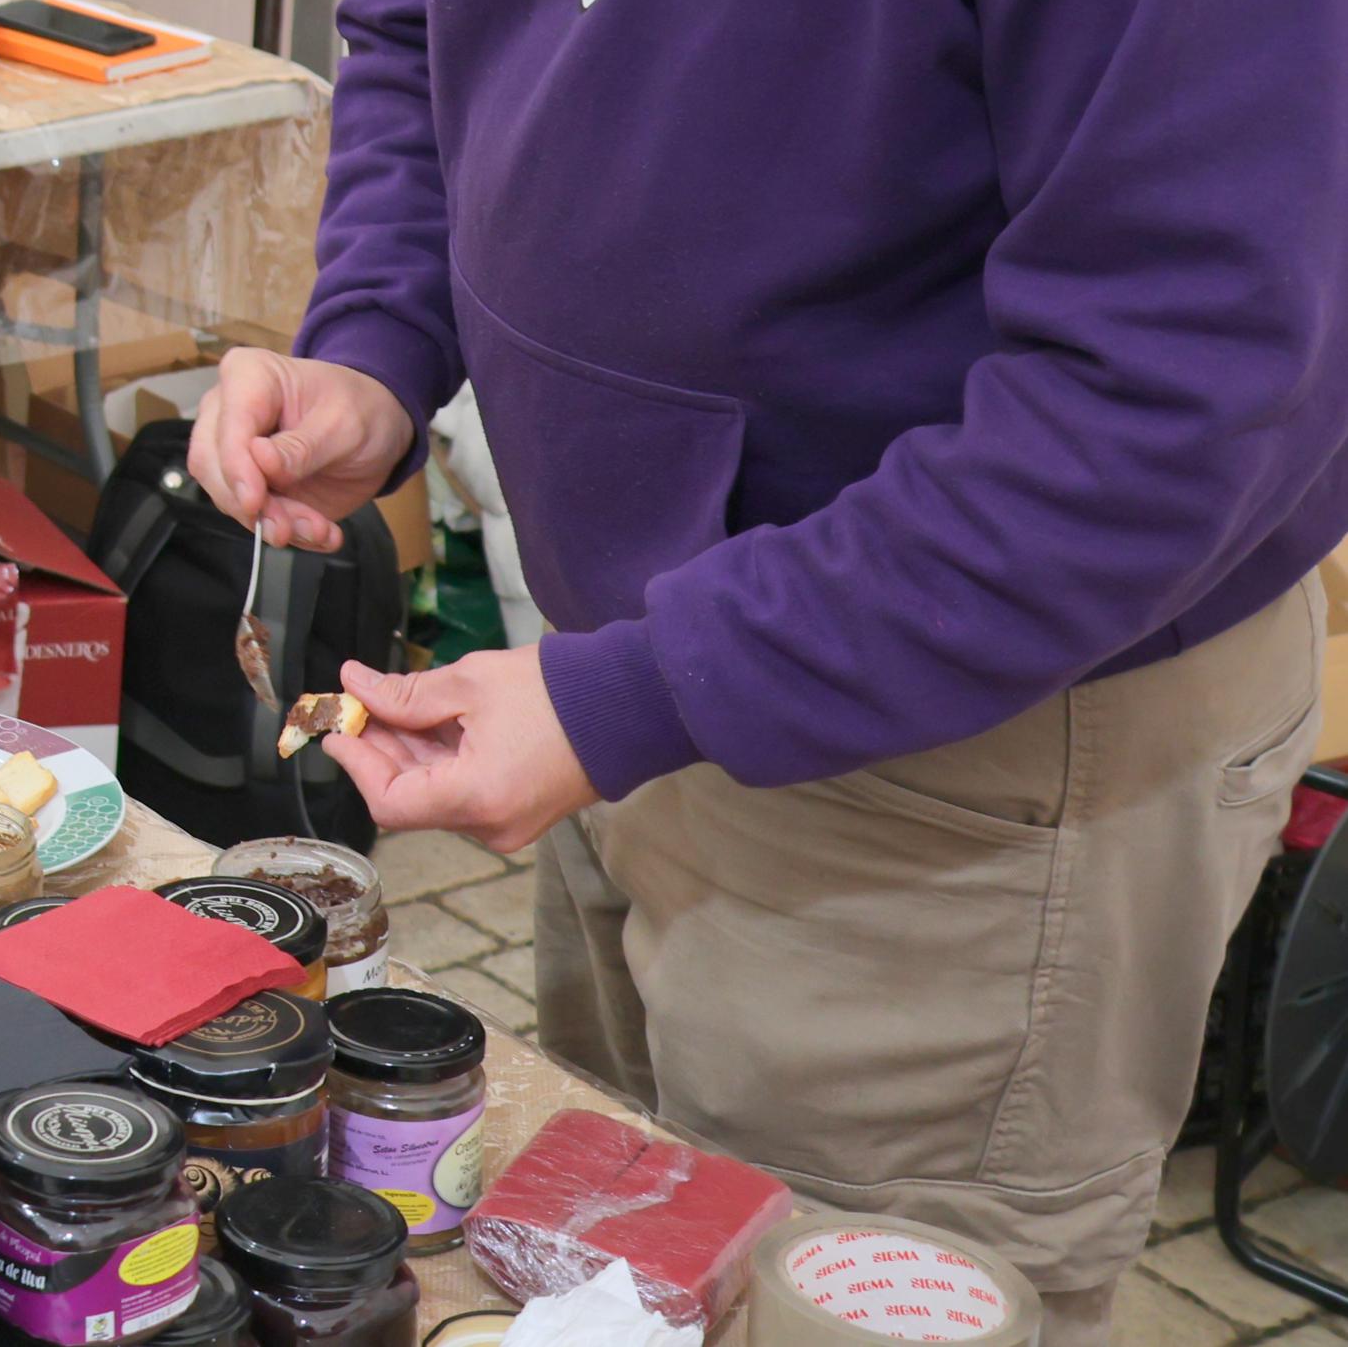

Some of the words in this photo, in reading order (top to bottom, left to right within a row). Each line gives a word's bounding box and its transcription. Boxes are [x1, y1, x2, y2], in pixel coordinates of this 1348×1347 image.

[210, 1009, 277, 1028] copal
[873, 1250, 920, 1264] SIGMA
[936, 1252, 976, 1271] SIGMA
[6, 1263, 19, 1280] de
[21, 1268, 46, 1290] Uva
[815, 1257, 856, 1280] SIGMA
[847, 1278, 894, 1295] SIGMA
[911, 1276, 955, 1293] SIGMA
[968, 1285, 998, 1306] SIGMA
[885, 1304, 931, 1318] SIGMA
[946, 1308, 983, 1329] SIGMA
